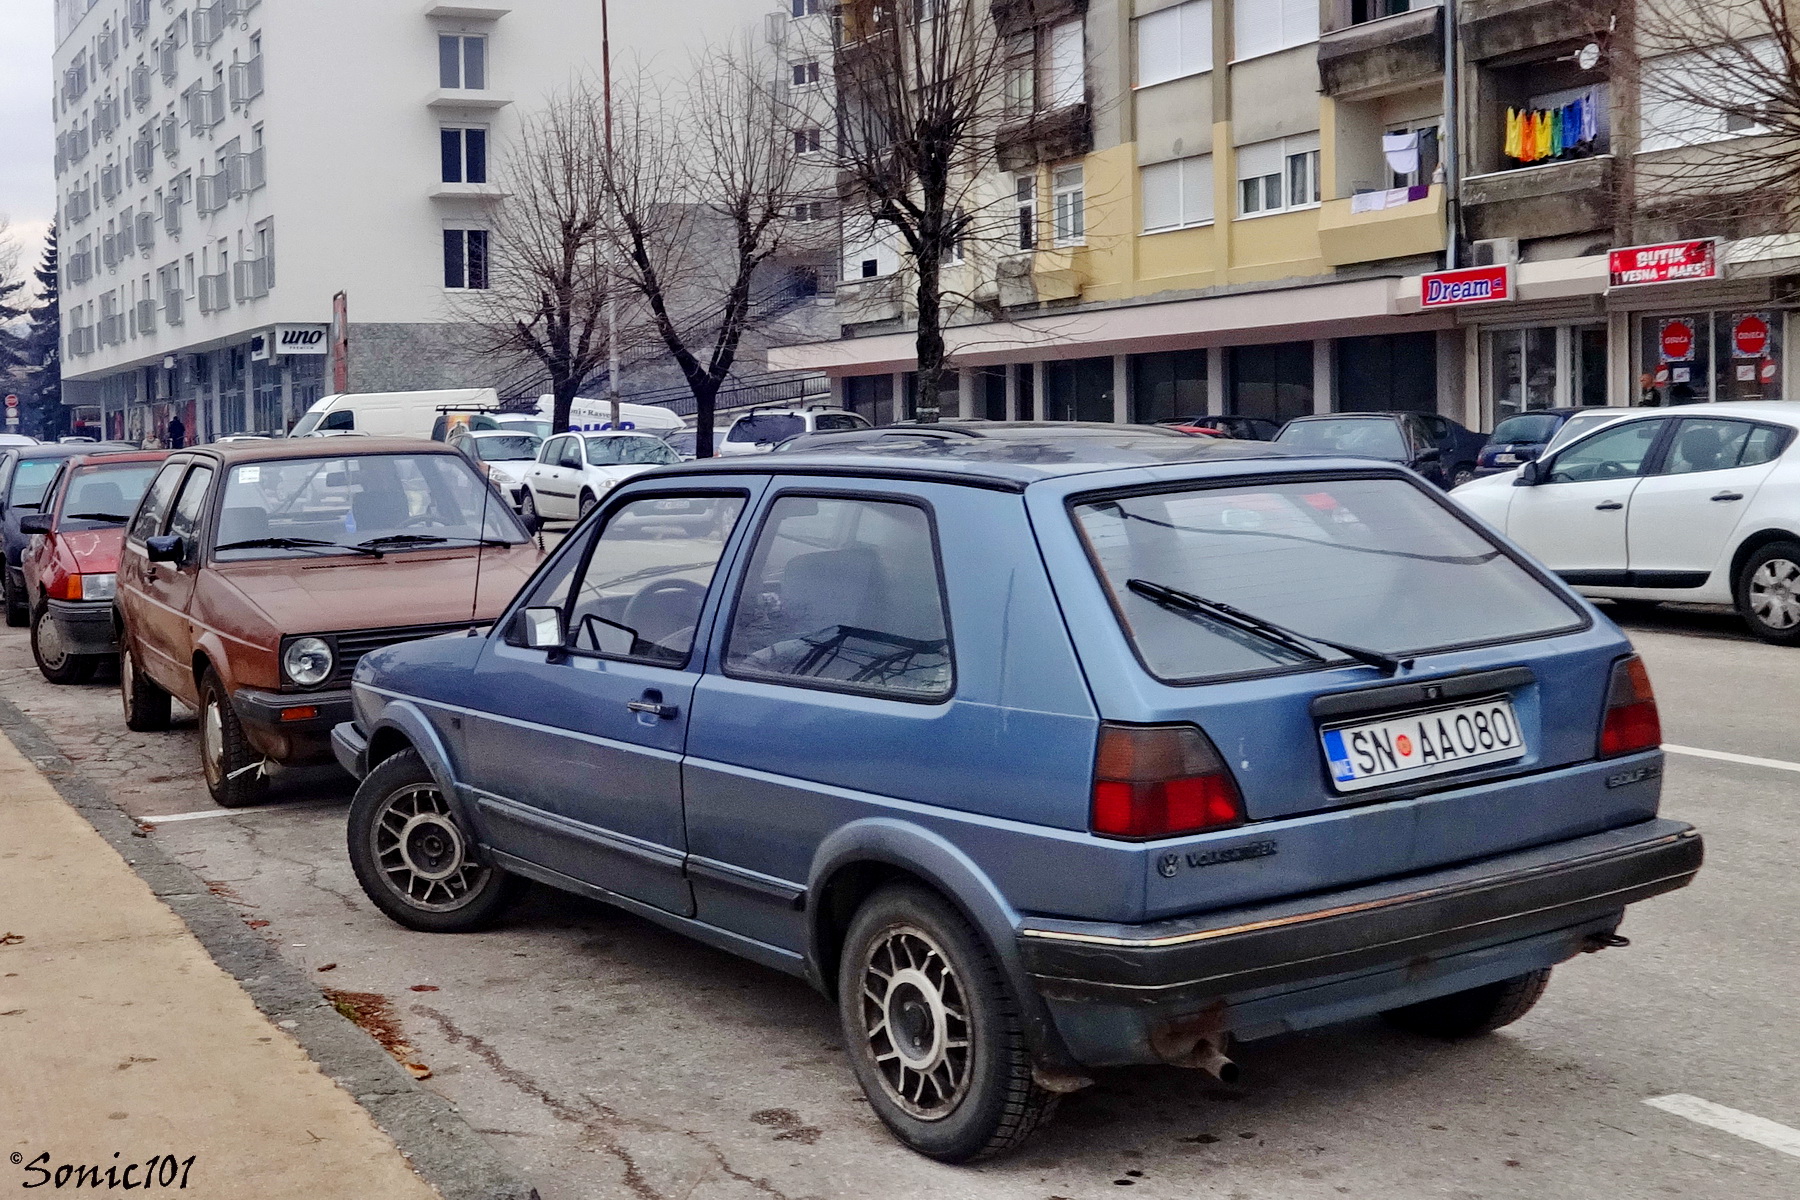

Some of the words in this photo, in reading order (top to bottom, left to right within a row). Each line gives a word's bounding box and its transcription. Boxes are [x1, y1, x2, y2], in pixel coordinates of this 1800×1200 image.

[1636, 247, 1687, 267] BUTIK
[1622, 268, 1659, 282] VESNA
[1427, 279, 1490, 302] Dream
[281, 330, 325, 344] uno
[1418, 707, 1512, 763] AA080
